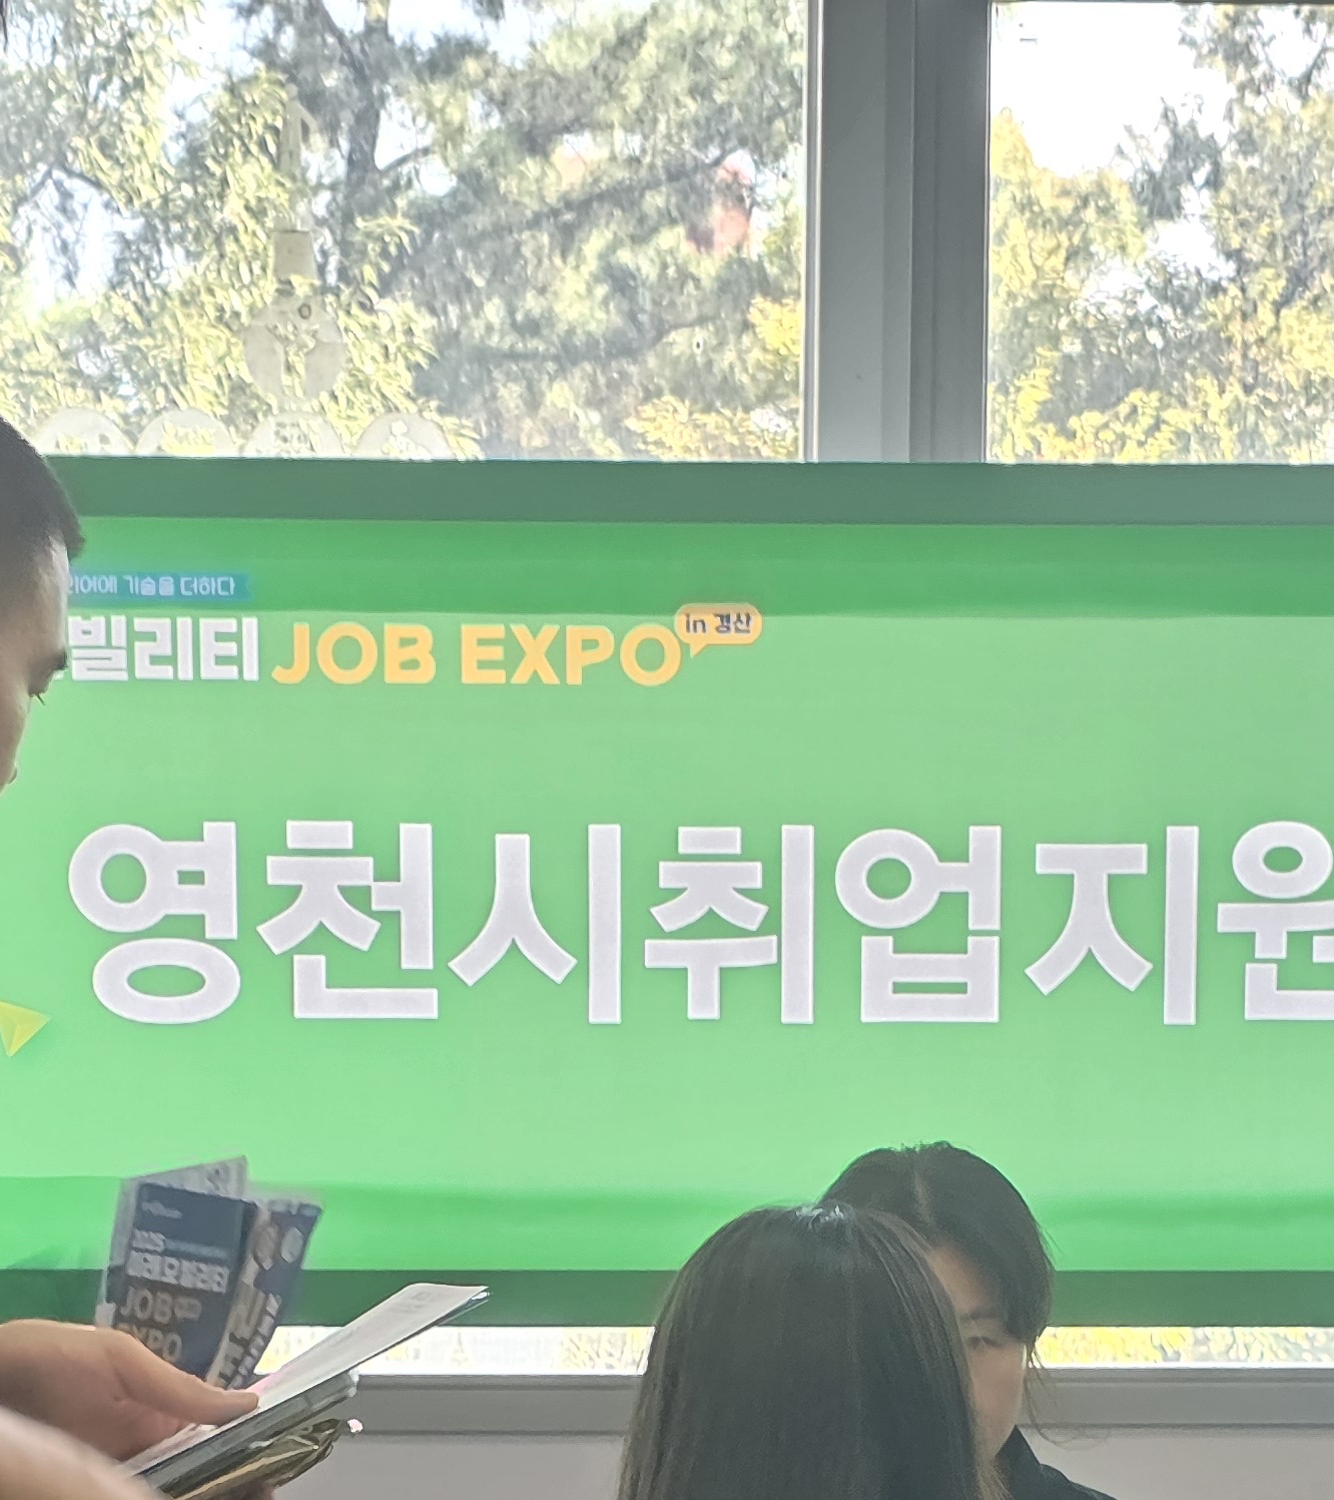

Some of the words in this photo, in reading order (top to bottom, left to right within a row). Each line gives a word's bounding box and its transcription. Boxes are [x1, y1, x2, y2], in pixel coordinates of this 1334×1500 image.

[683, 611, 707, 634] in
[713, 611, 753, 635] 경산
[53, 614, 261, 682] 빌리티
[270, 620, 437, 685] JOB
[460, 621, 682, 687] EXPO
